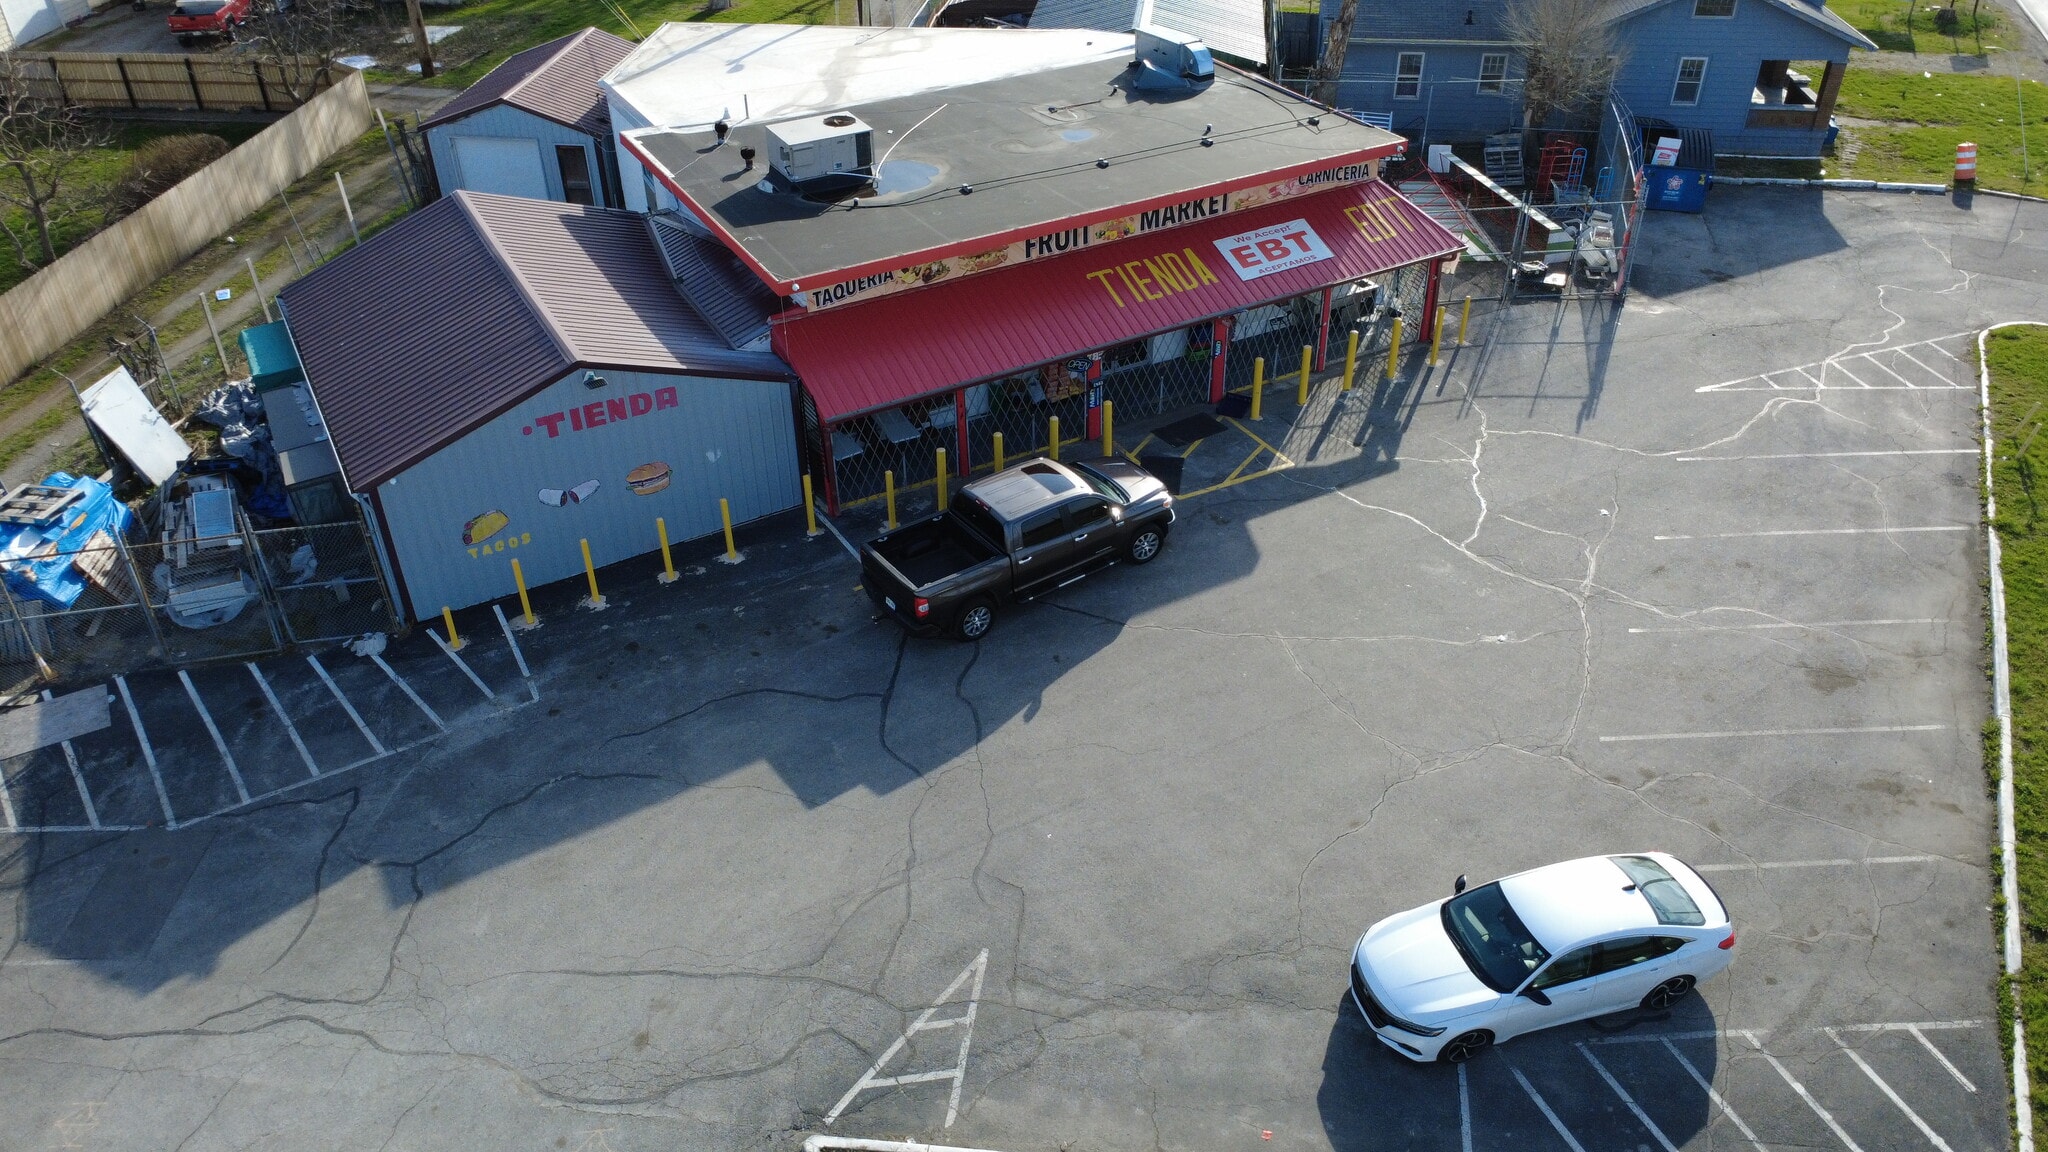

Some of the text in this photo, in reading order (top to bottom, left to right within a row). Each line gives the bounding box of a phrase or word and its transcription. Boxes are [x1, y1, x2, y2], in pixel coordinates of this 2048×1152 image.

[1298, 164, 1369, 185] CARNICERIA
[1025, 193, 1228, 258] FRUIT MARKET
[1254, 225, 1291, 239] Accept
[1229, 230, 1313, 269] EBT
[1258, 255, 1317, 274] ACEPTAMOS
[812, 271, 894, 307] TAQUERIA
[1086, 248, 1219, 308] TIENDA
[1068, 360, 1091, 370] OPEN
[535, 386, 679, 438] TIENDA
[466, 533, 531, 559] TACOS
